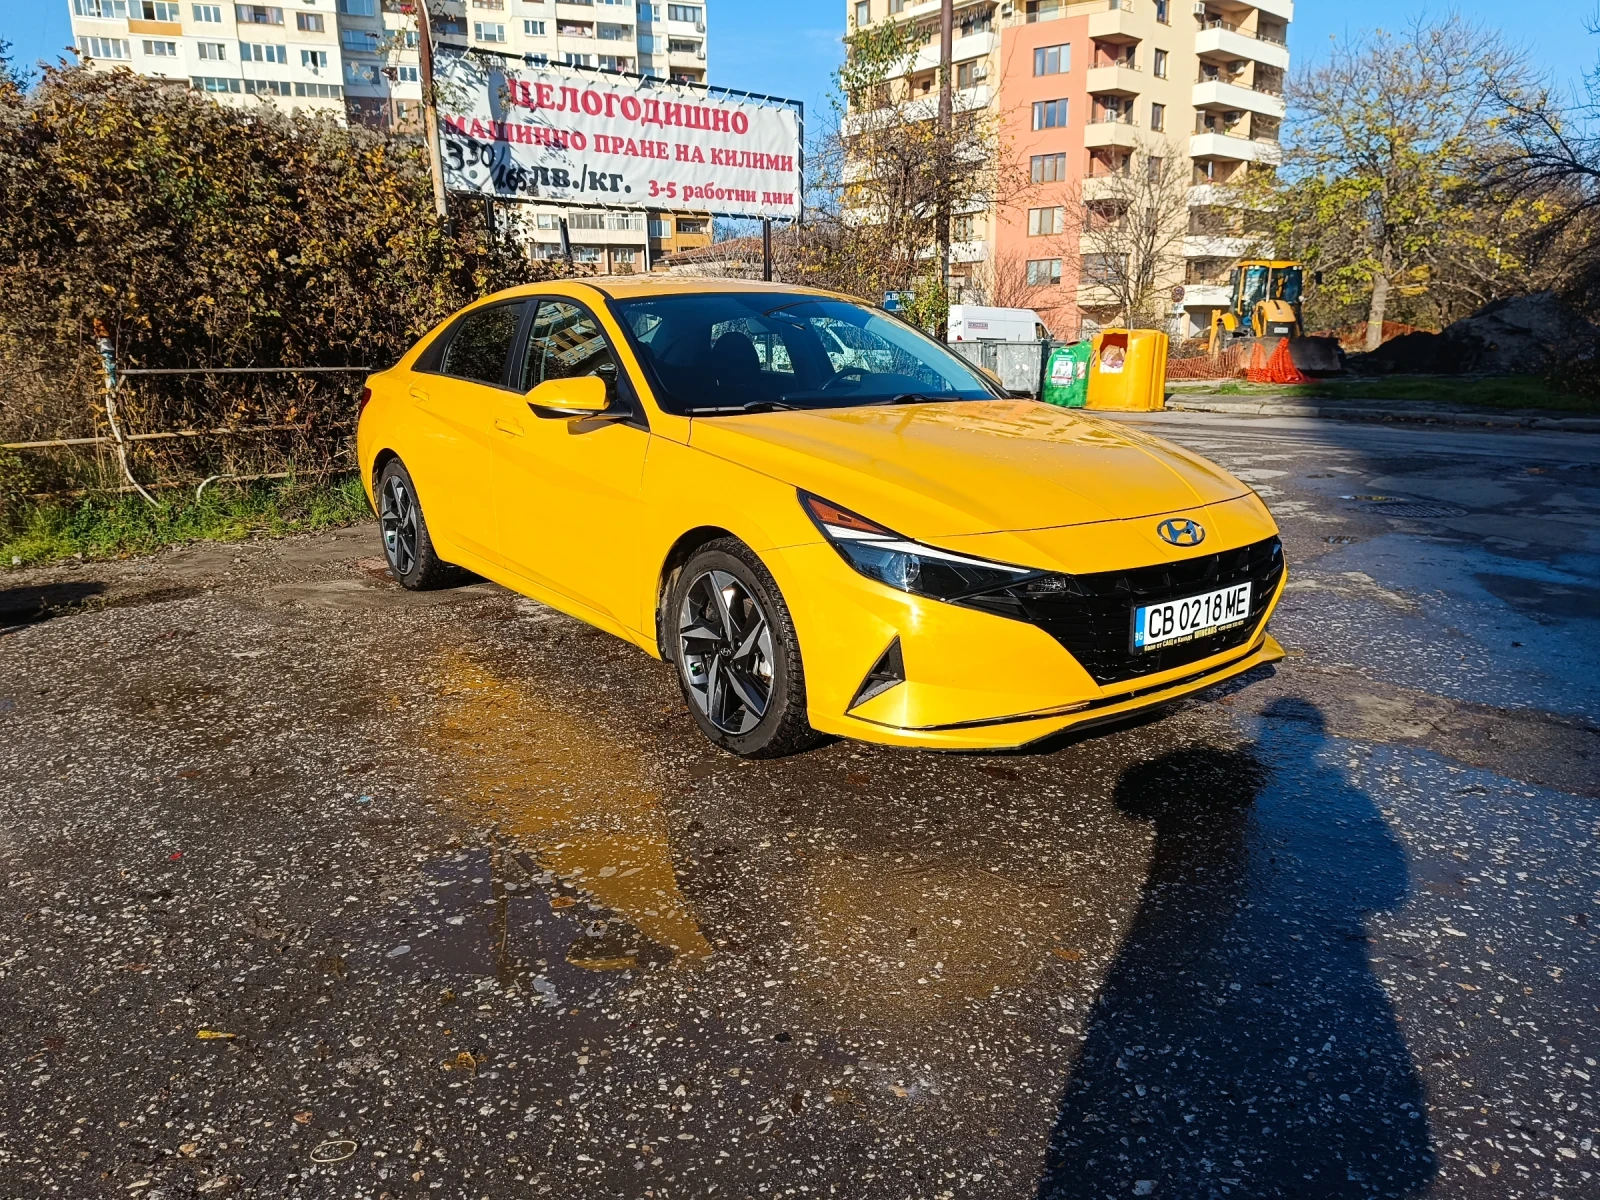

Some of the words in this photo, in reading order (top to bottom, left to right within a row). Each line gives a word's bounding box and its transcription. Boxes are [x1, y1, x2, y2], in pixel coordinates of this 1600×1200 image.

[507, 78, 749, 134] ЦЕЛОГОДИШНО
[444, 114, 587, 151] МАШИННО
[593, 134, 670, 160] ПРАНЕ
[675, 143, 705, 164] НА
[710, 147, 794, 172] КИЛИМИ
[648, 179, 677, 198] 3-5
[682, 182, 757, 203] работни
[762, 191, 794, 206] дни
[1179, 593, 1222, 630] 0218
